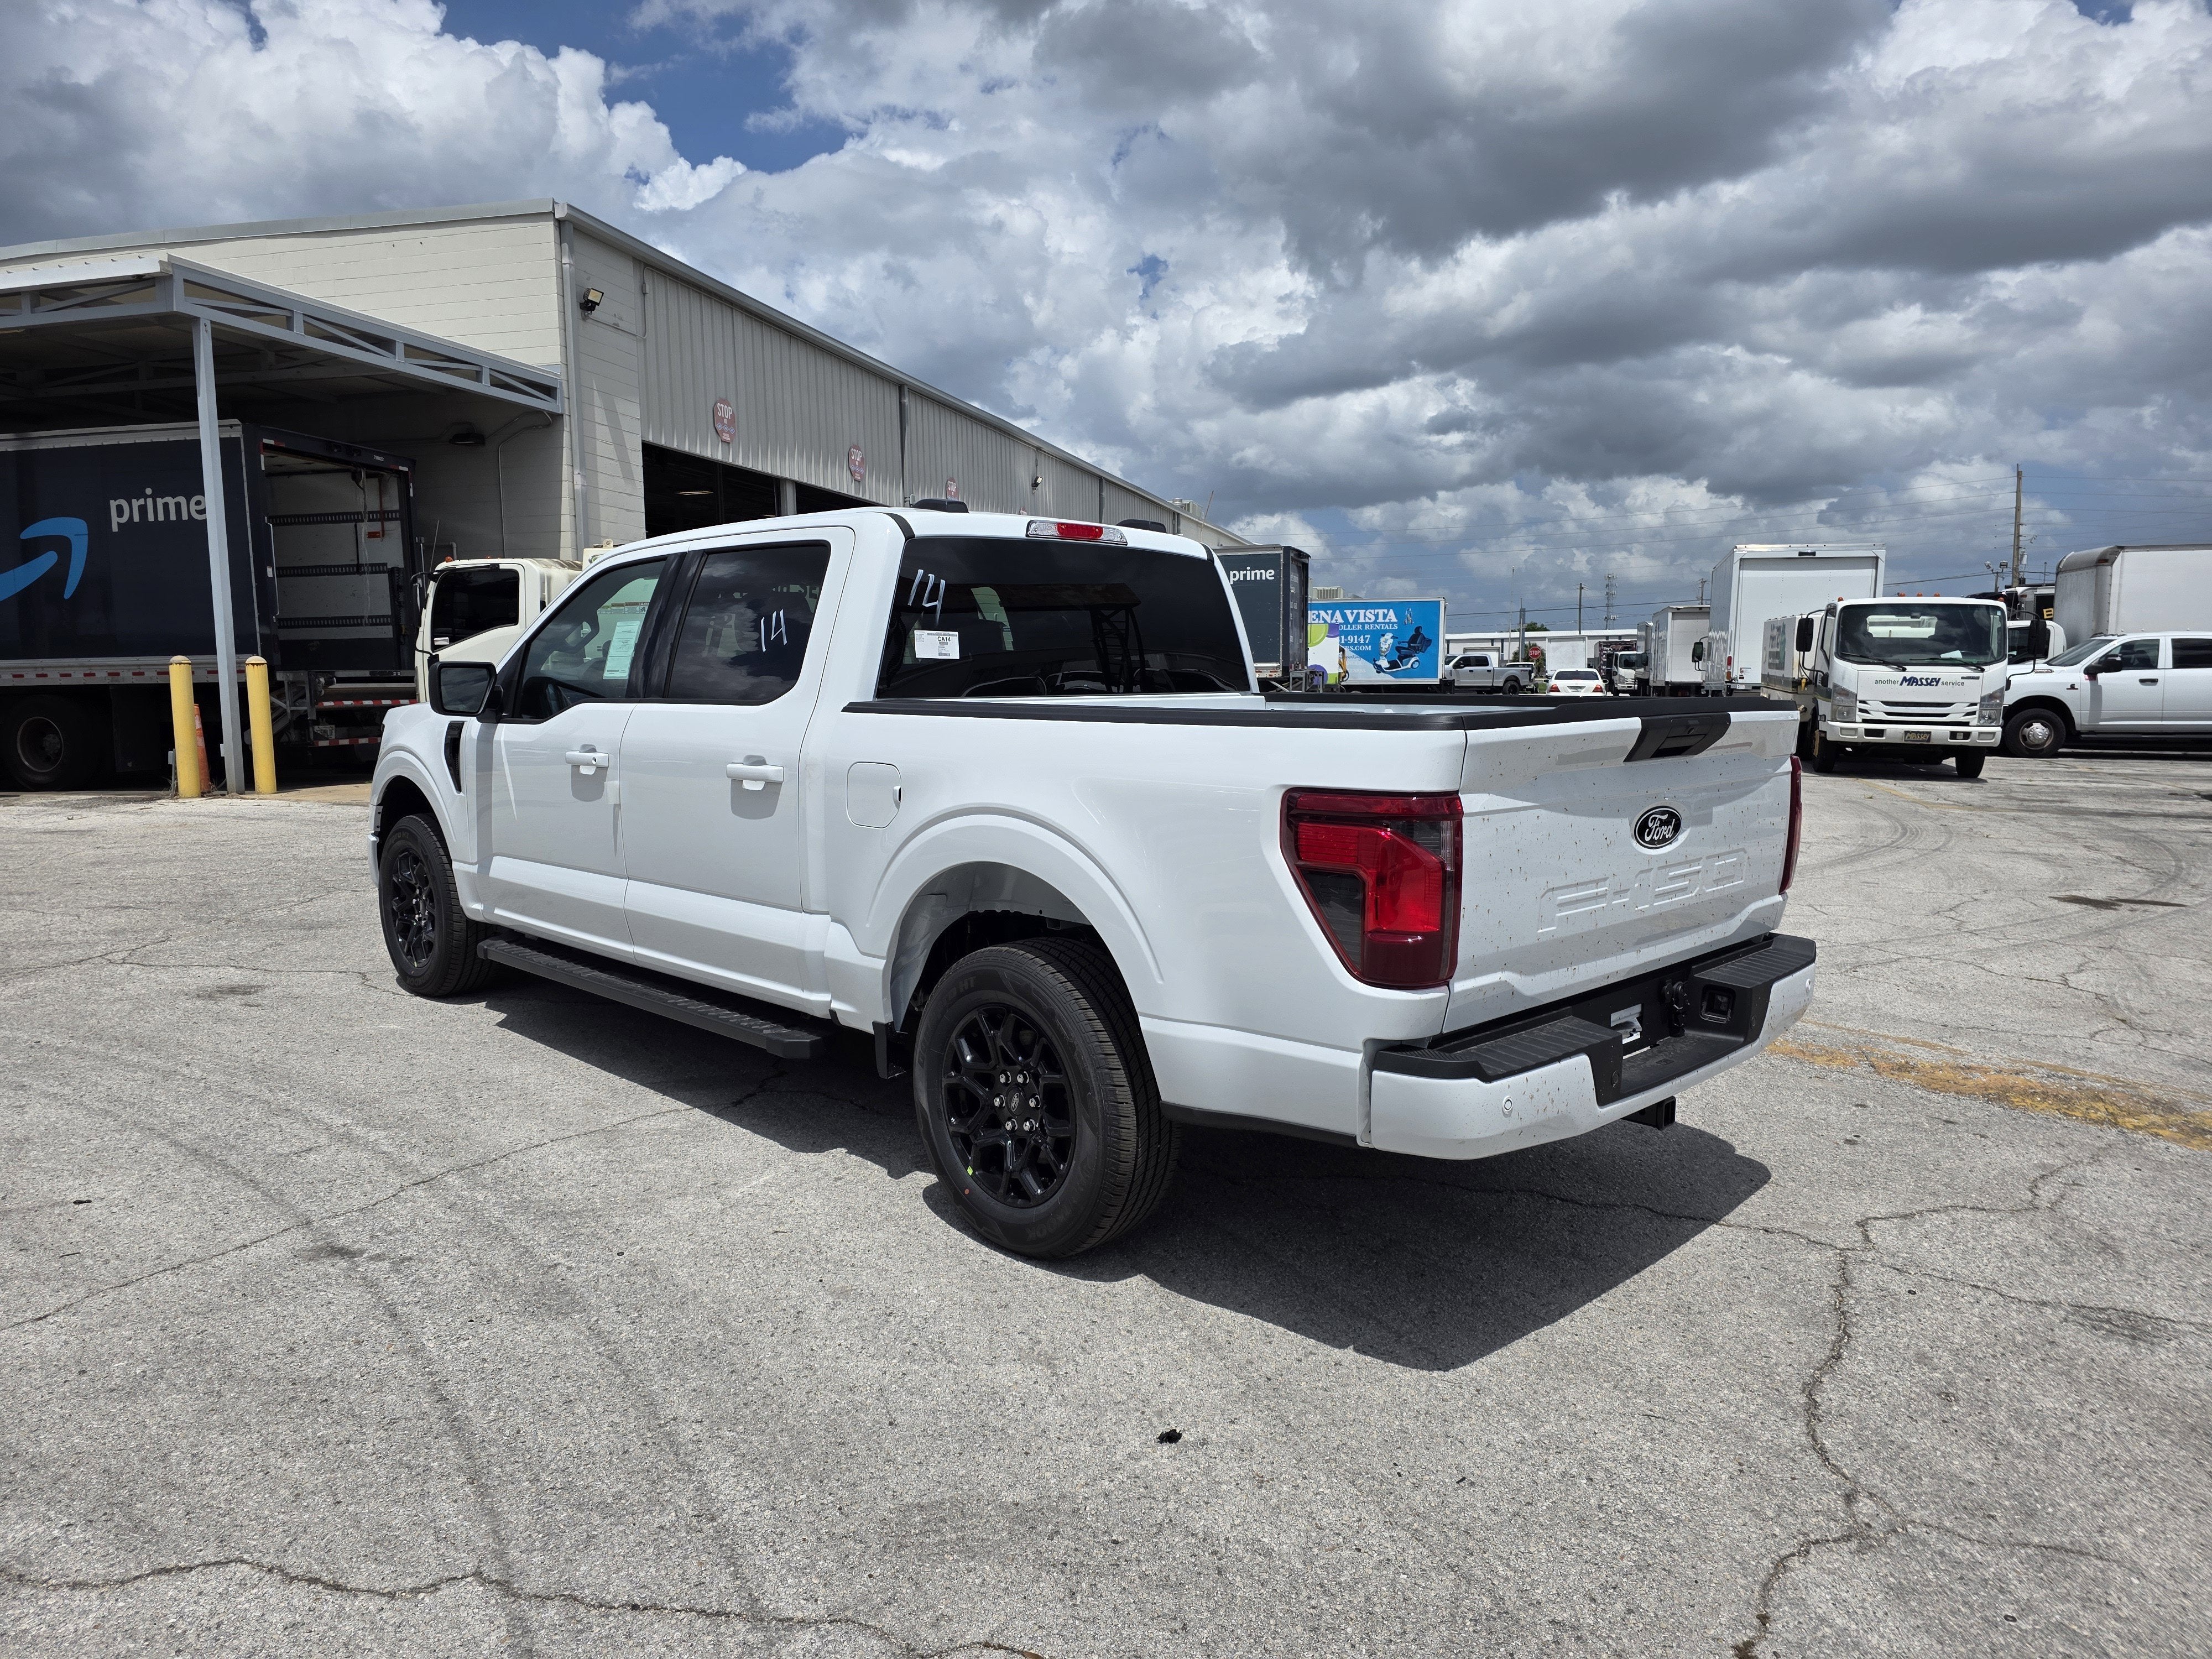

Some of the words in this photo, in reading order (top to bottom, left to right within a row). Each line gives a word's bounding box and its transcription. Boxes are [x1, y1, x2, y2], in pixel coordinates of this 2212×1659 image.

[717, 403, 732, 419] STOP
[852, 448, 862, 462] STOP
[109, 488, 206, 532] prime
[1229, 566, 1275, 585] prime
[907, 569, 945, 627] 14
[1344, 609, 1397, 623] VISTA
[760, 609, 787, 652] 14
[1900, 676, 1941, 686] MASSEY
[1645, 813, 1676, 842] Ford
[1537, 847, 1747, 933] F-150
